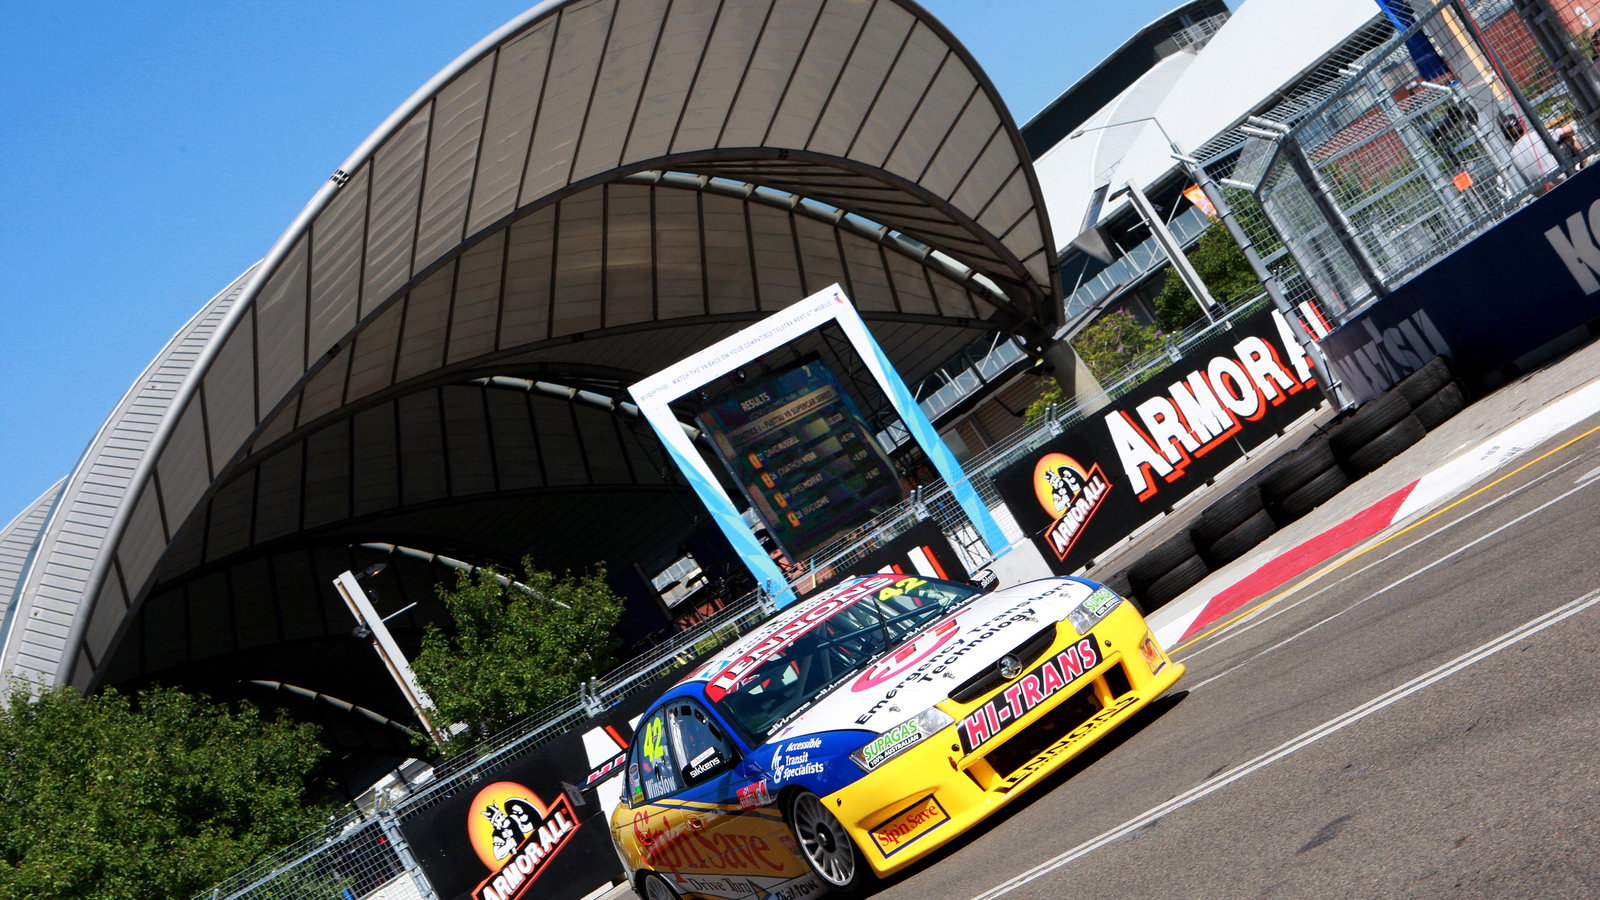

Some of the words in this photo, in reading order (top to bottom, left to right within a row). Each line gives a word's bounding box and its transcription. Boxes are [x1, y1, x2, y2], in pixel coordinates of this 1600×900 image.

[672, 373, 690, 385] WATCH
[690, 367, 700, 376] THE
[708, 357, 721, 367] RACE
[720, 353, 730, 361] ON
[729, 345, 744, 356] YOUR
[743, 330, 773, 349] COMPATIBLE
[773, 320, 793, 334] TELSTRA
[793, 314, 806, 323] NEXT
[814, 301, 832, 313] MOBILE
[740, 391, 771, 413] RESULTS
[763, 413, 786, 429] FUJITSU
[783, 410, 792, 419] V8
[790, 398, 817, 416] SUPERCAR
[815, 389, 833, 403] SERIES
[777, 435, 800, 451] RUSSELL
[801, 451, 817, 464] WEBB
[802, 473, 824, 489] MOFFAT
[814, 496, 830, 508] LOWE
[878, 577, 928, 602] 42
[711, 576, 897, 691] LENNONS
[917, 608, 1037, 684] Technology
[854, 638, 965, 725] Emergency
[967, 581, 1074, 634] Transport
[964, 638, 1098, 750] HI-TRANS
[643, 717, 665, 762] 42
[785, 737, 823, 752] Accessible
[863, 720, 919, 761] SUPAGAS
[869, 754, 884, 768] 100%
[884, 733, 920, 759] AUSTRALIAN
[992, 696, 1141, 795] LENNONS
[689, 756, 721, 778] sikkens
[783, 762, 825, 780] Specialists
[785, 754, 809, 767] Transit
[645, 775, 677, 800] Winslow
[908, 804, 939, 829] Save
[693, 828, 785, 872] Save
[687, 877, 723, 893] Drive
